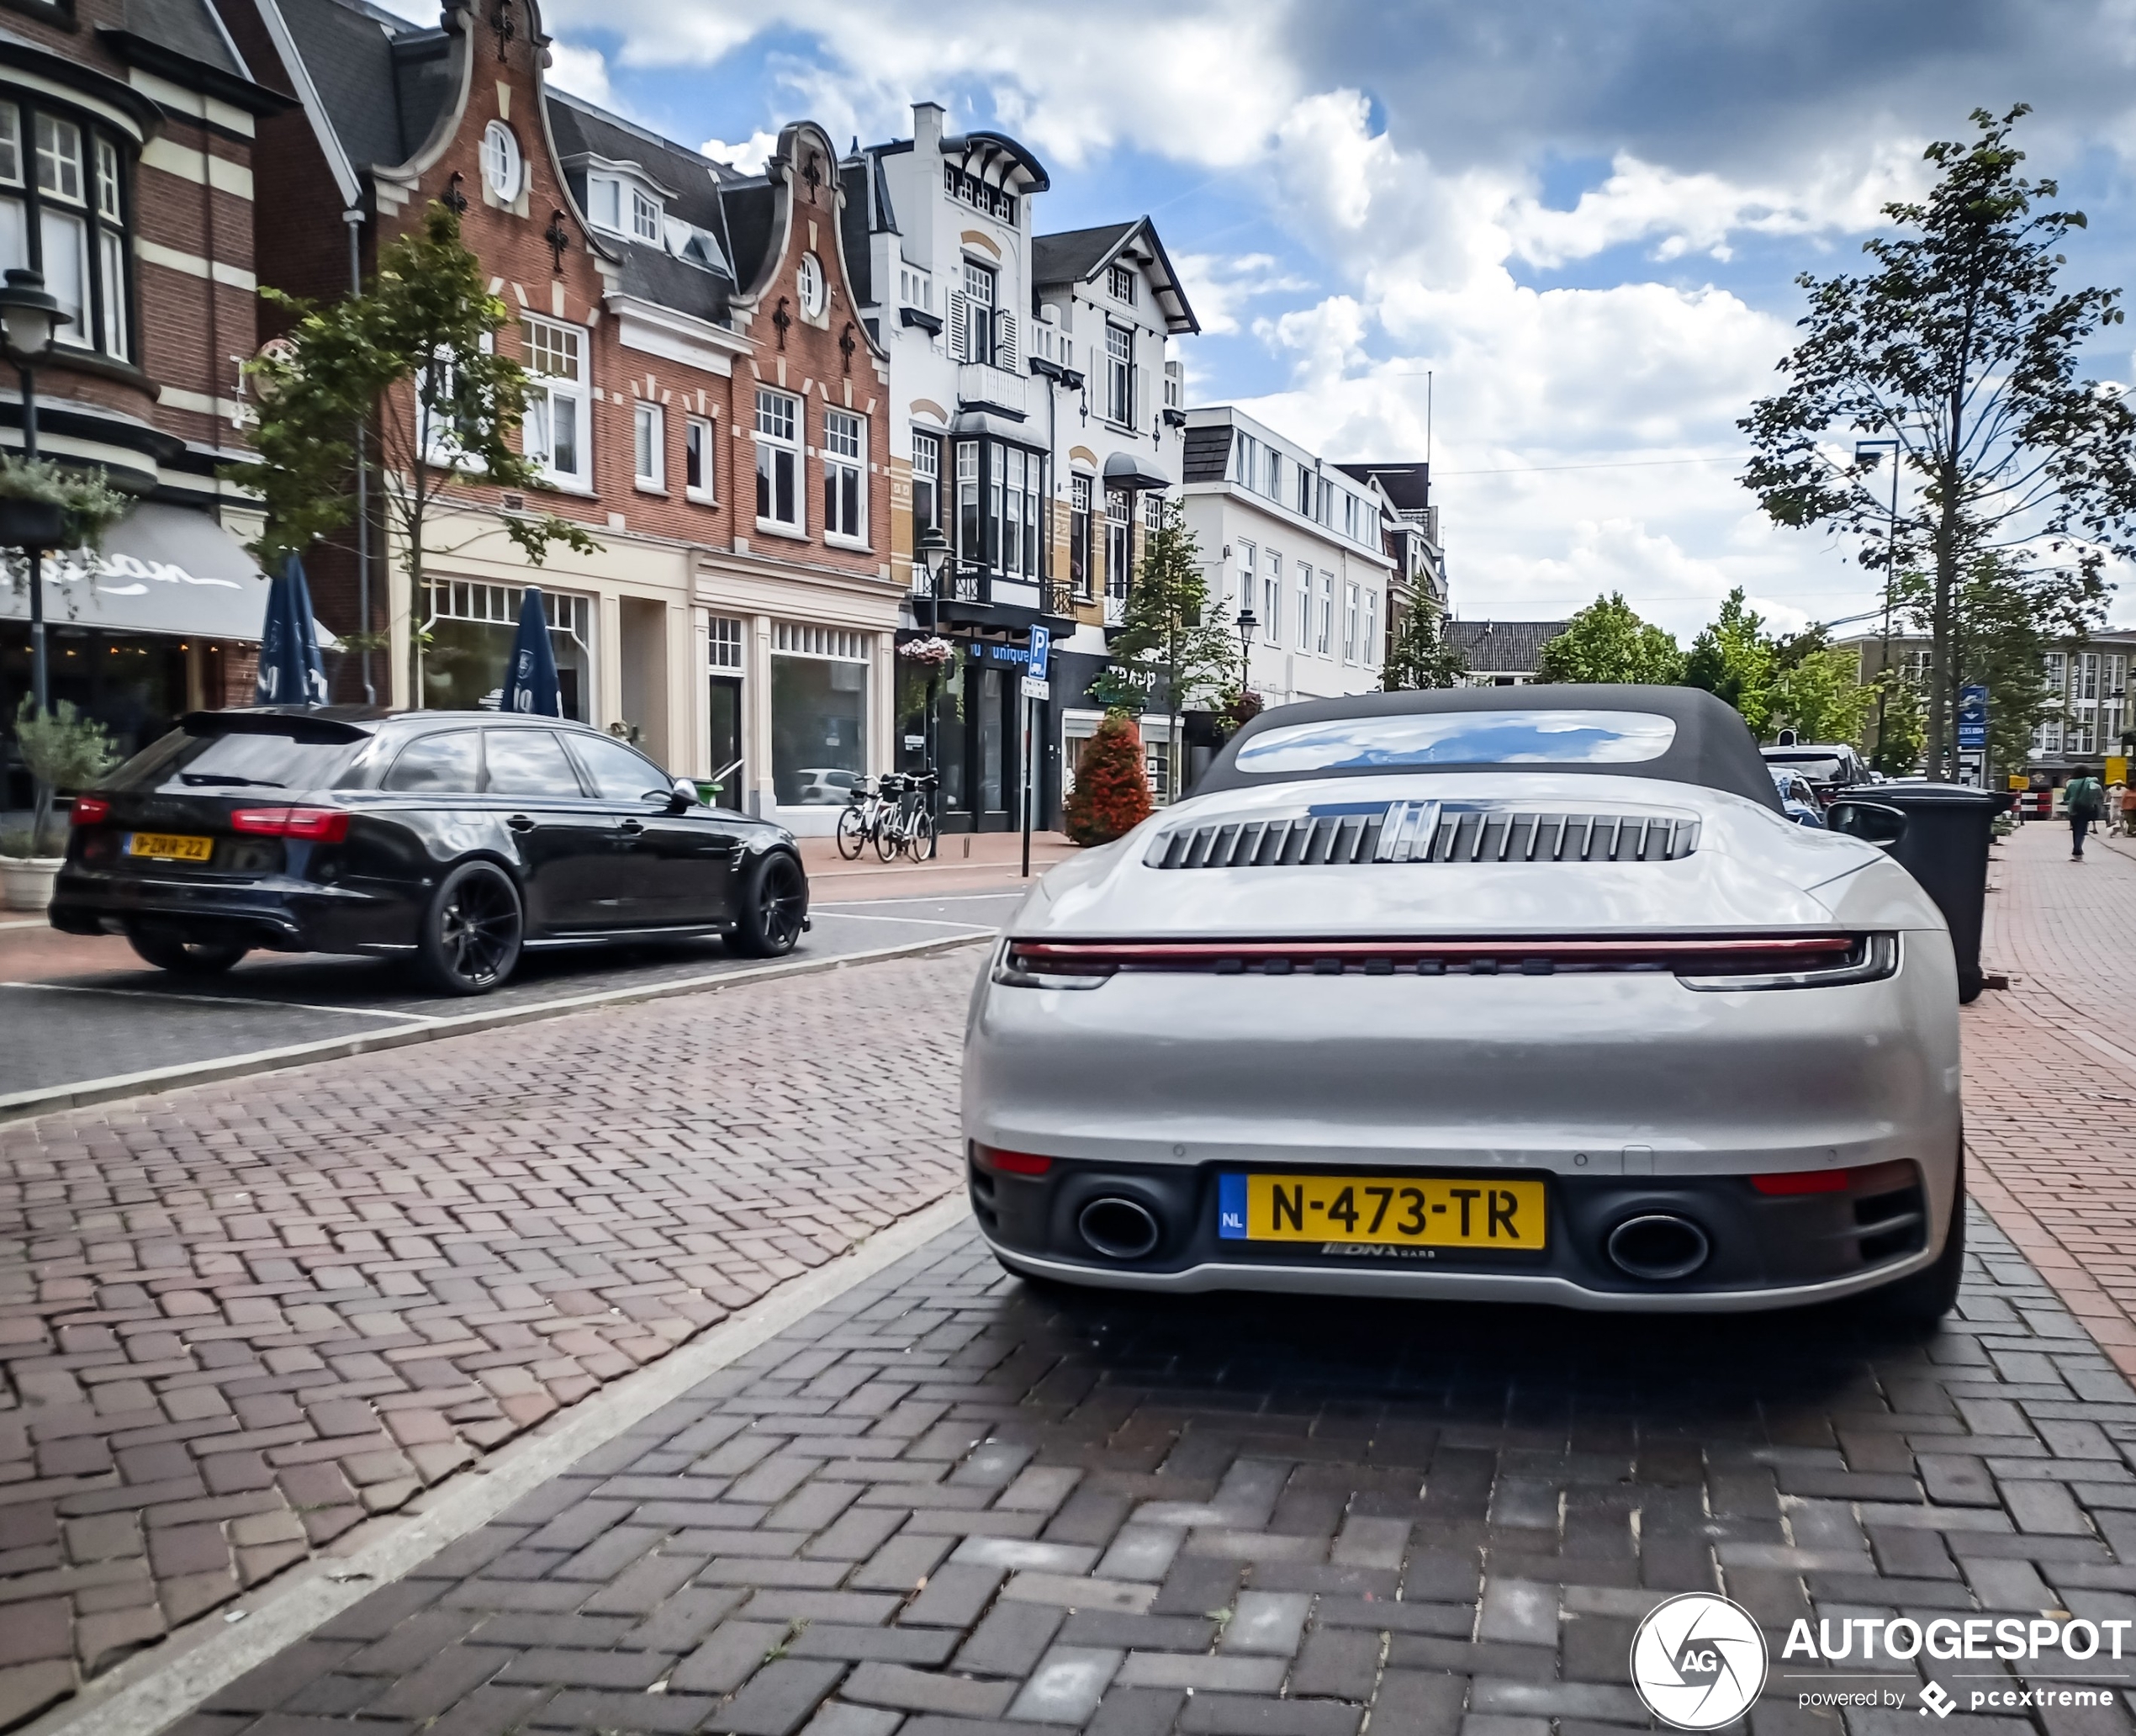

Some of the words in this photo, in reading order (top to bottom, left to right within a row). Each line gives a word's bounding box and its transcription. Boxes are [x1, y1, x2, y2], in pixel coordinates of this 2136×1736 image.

[992, 643, 1029, 665] unique
[1034, 631, 1045, 658] P
[1222, 1212, 1244, 1228] NL
[1272, 1183, 1520, 1239] N-473-TR
